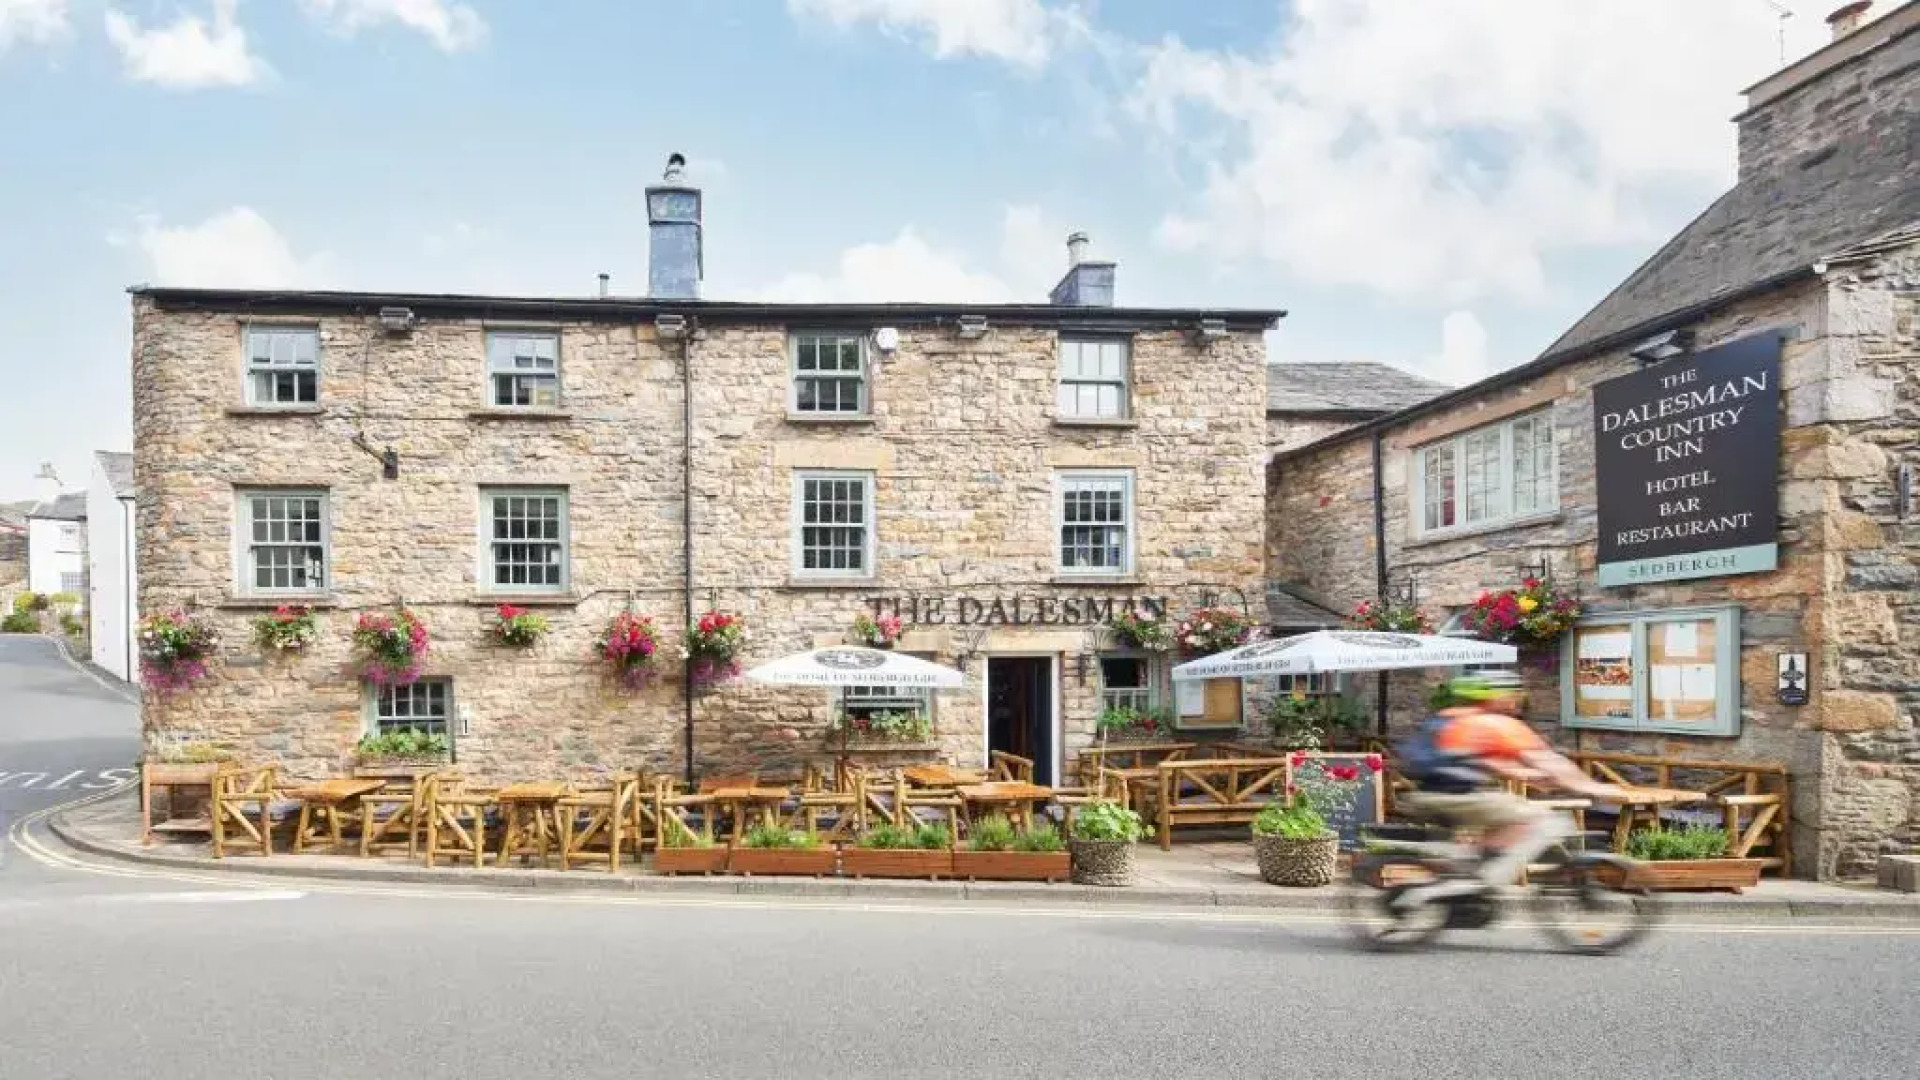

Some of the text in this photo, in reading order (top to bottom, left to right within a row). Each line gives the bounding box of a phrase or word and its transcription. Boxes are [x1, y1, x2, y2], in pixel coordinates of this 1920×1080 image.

[1661, 369, 1698, 389] THE
[1602, 371, 1769, 432] DALESMAN
[1621, 406, 1744, 450] COUNTRY
[1656, 437, 1704, 462] INN
[1646, 470, 1717, 496] HOTEL
[1659, 498, 1701, 517] BAR
[1617, 512, 1753, 547] RESTAURANT
[1627, 554, 1737, 578] SEDBERGH
[866, 597, 946, 625] THE
